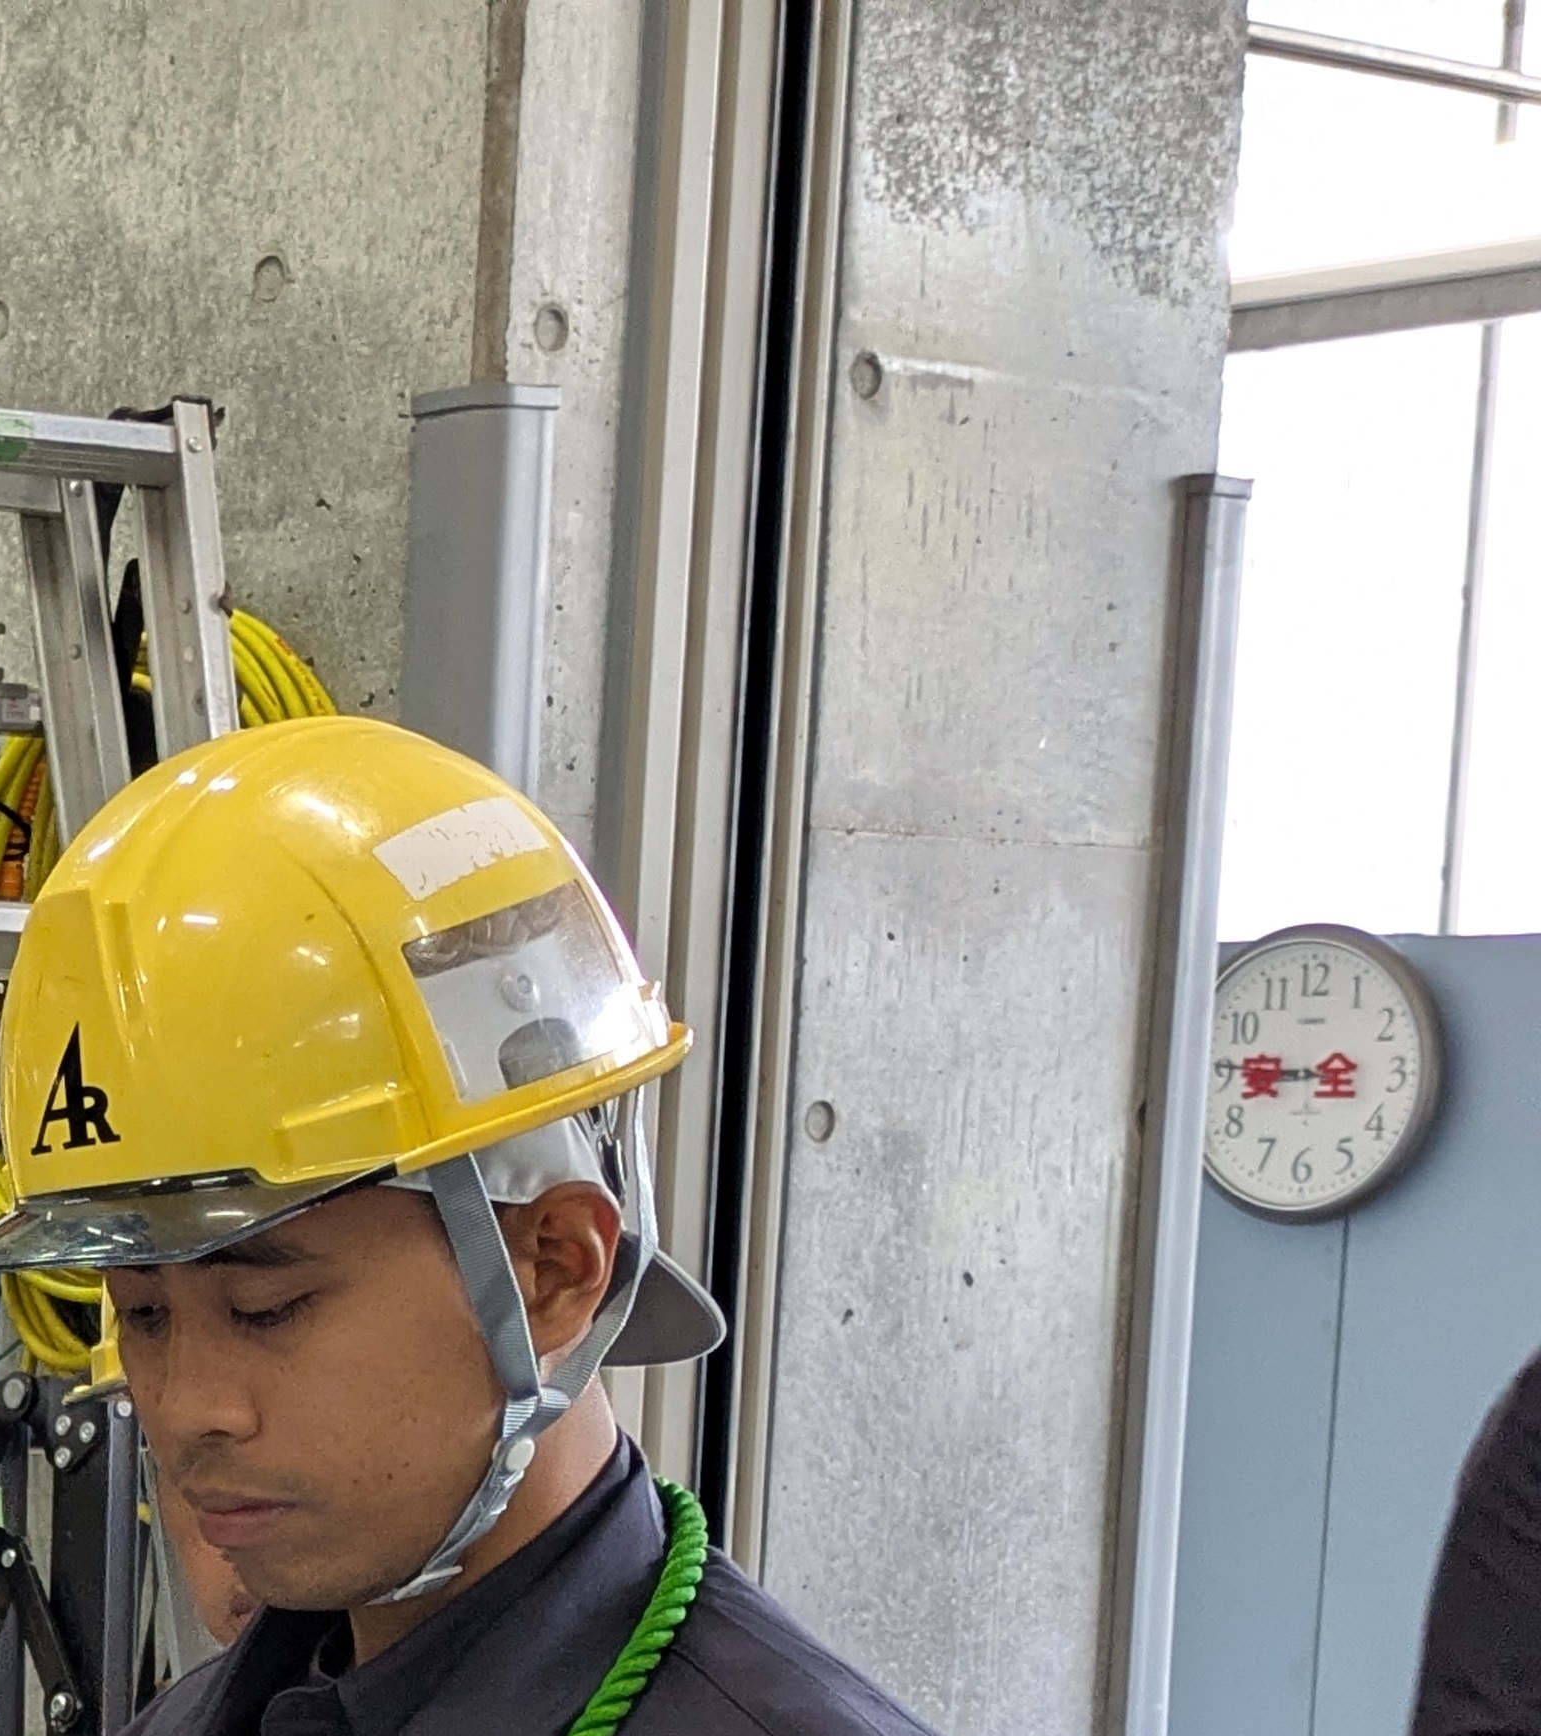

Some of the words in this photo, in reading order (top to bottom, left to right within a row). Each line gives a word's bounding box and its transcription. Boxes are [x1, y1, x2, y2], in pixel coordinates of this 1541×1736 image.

[1263, 976, 1290, 1011] 11
[1300, 963, 1330, 998] 12
[1350, 975, 1363, 1010] 1
[1229, 1010, 1260, 1044] 10
[1376, 1008, 1395, 1042] 2
[1240, 1052, 1357, 1099] 安全
[1385, 1056, 1408, 1093] 3
[1224, 1104, 1245, 1138] 8
[1365, 1102, 1386, 1140] 4
[1257, 1137, 1277, 1172] 7
[1291, 1147, 1313, 1184] 6
[1334, 1137, 1354, 1174] 5
